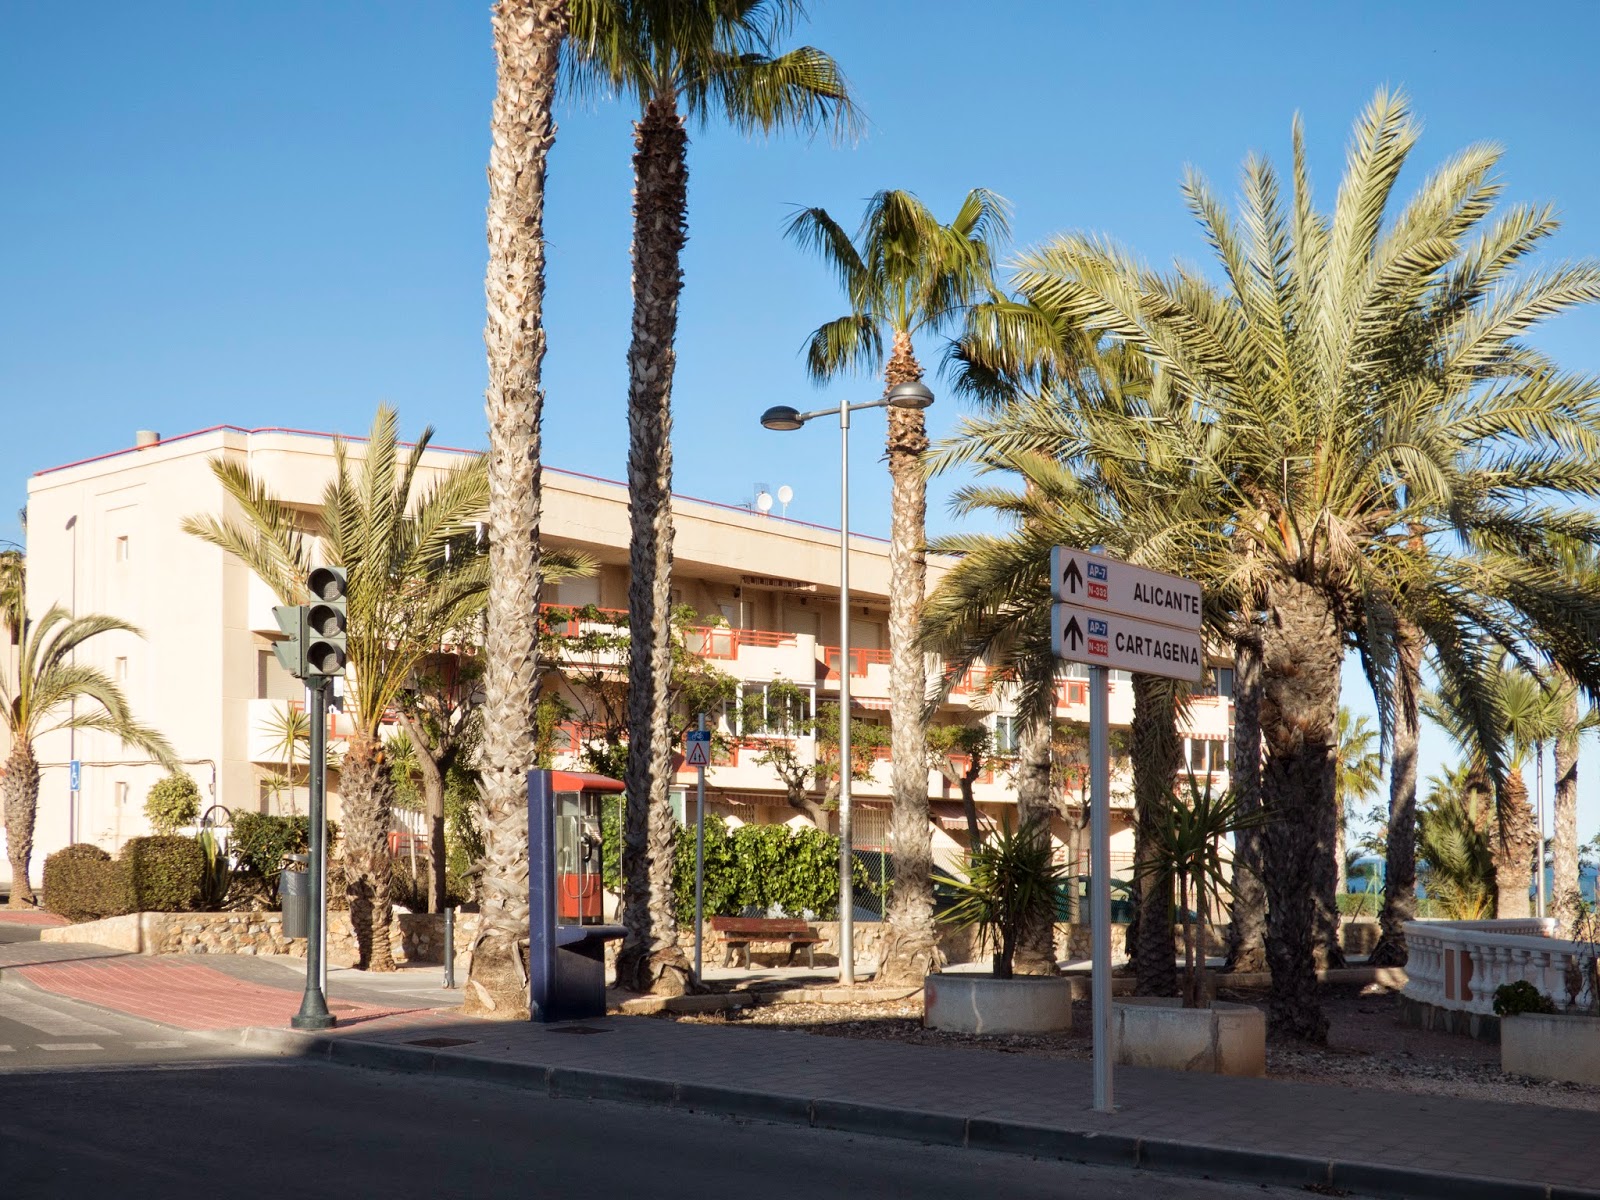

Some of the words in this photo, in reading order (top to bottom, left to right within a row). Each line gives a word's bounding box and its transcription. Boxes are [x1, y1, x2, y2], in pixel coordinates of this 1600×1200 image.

[1089, 564, 1106, 579] AP-7
[1088, 585, 1107, 598] N-332
[1133, 582, 1199, 615] ALICANTE
[1089, 620, 1106, 635] AP-7
[1088, 641, 1107, 654] N-332
[1115, 632, 1199, 666] CARTAGENA
